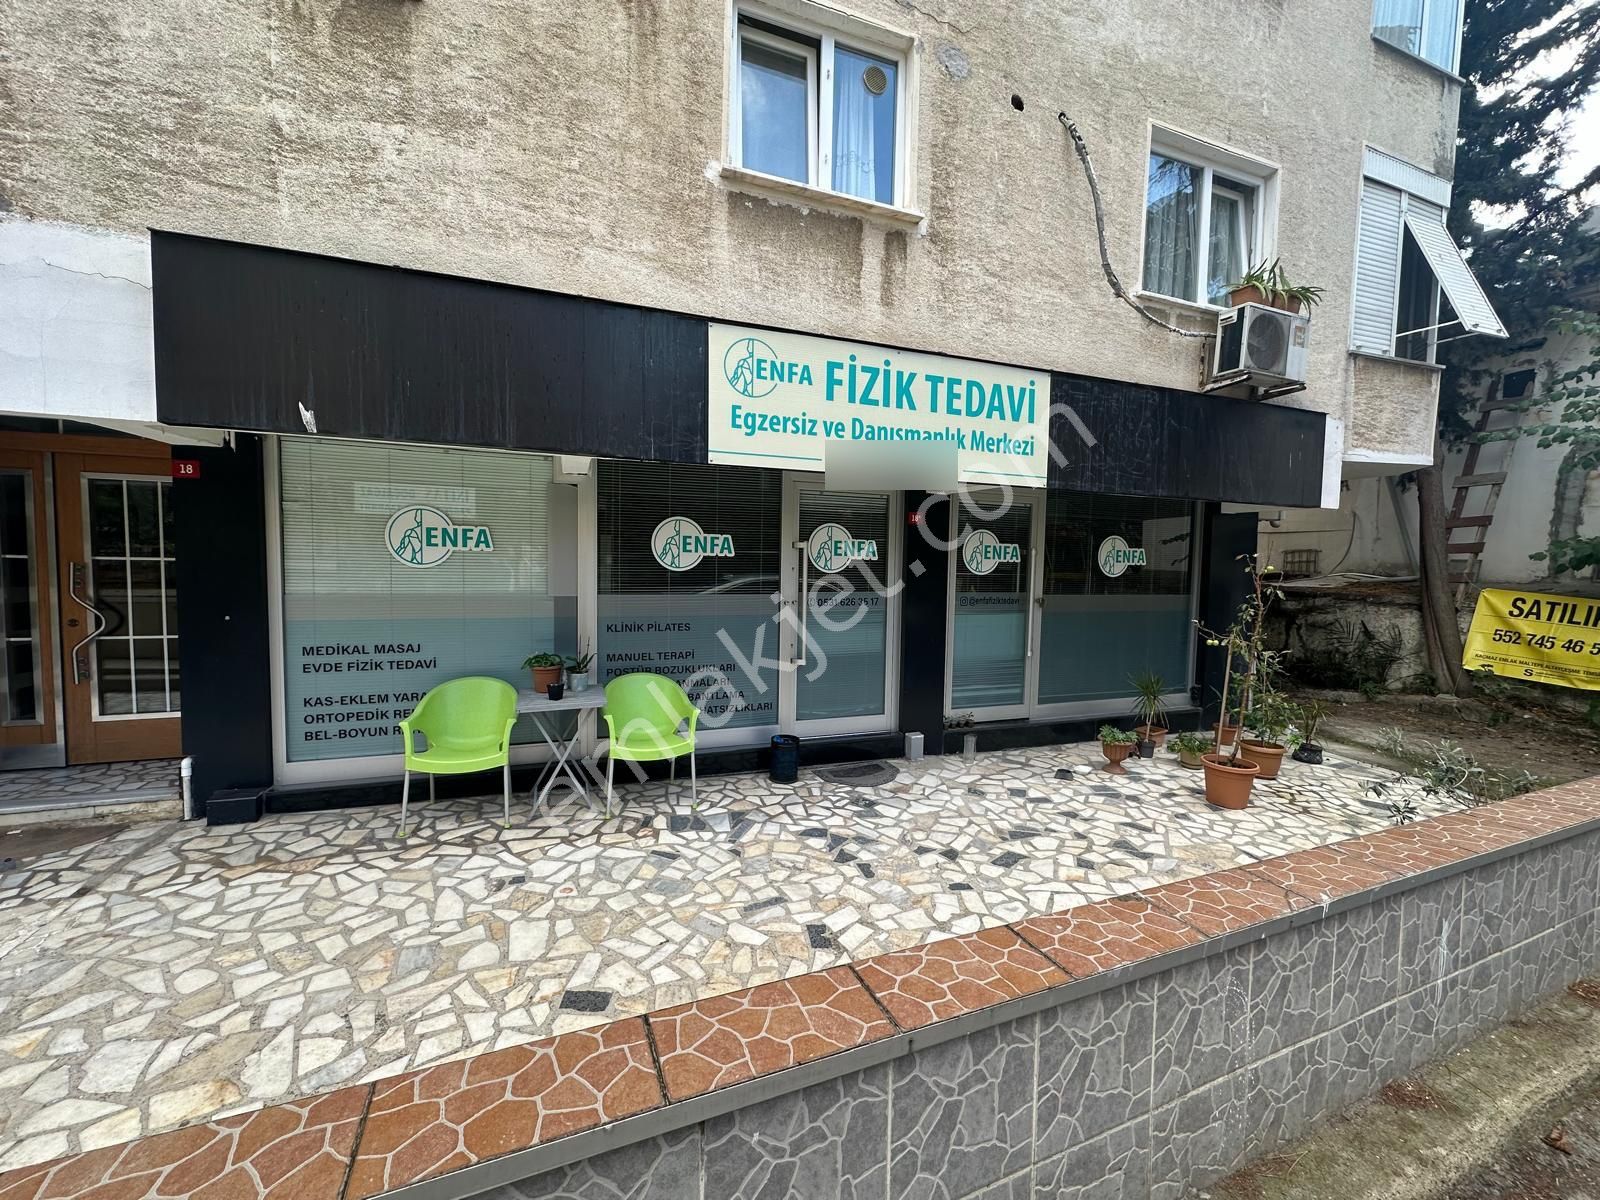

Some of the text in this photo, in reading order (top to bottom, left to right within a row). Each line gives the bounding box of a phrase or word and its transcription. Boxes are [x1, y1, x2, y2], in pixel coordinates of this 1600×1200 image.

[756, 358, 813, 386] ENFA
[825, 354, 1036, 424] FİZİK TEDAVİ
[731, 404, 818, 437] Egzersiz
[822, 419, 846, 439] ve
[970, 429, 1034, 456] Merkezi
[179, 464, 193, 474] 18
[425, 527, 491, 549] ENFA
[682, 535, 733, 555] ENFA
[834, 540, 877, 558] ENFA
[983, 544, 1020, 561] ENFA
[1115, 549, 1146, 564] ENFA
[840, 597, 856, 606] 626
[870, 597, 879, 606] 17
[606, 621, 691, 633] KLİNİK PİLATES
[1492, 629, 1522, 645] 552
[1526, 633, 1557, 650] 745
[1561, 638, 1585, 653] 46
[302, 643, 421, 656] MEDİKAL MASAJ
[606, 649, 695, 662] MANUEL TERAPİ
[302, 656, 437, 673] EVDE FİZİK TEDAVİ
[655, 663, 736, 675] BOZUKLUKLARI
[303, 691, 428, 707] KAS-EKLEM YARA
[303, 708, 389, 724] ORTOPEDİK
[304, 726, 388, 741] BEL-BOYUN
